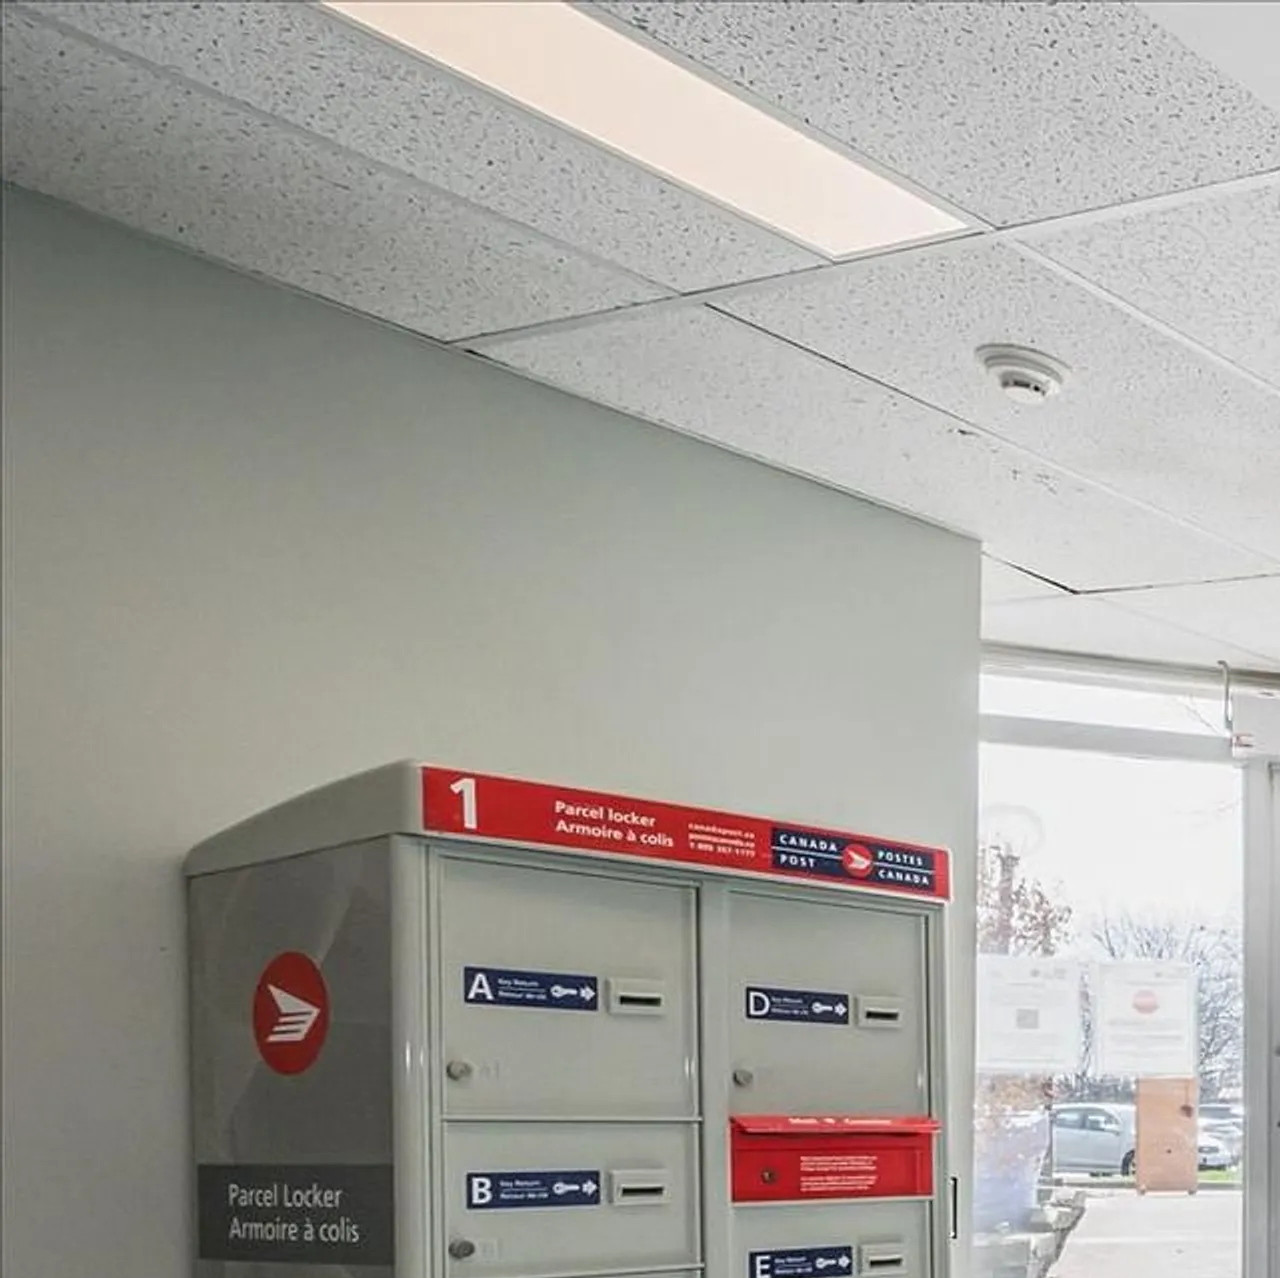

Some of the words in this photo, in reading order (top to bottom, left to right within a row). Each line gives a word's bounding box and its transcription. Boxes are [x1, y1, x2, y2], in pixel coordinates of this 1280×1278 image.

[450, 778, 477, 830] 1
[555, 800, 604, 820] Parcel
[608, 808, 656, 827] locker
[556, 819, 623, 840] Armoire
[640, 833, 674, 847] colis
[780, 834, 838, 852] CANADA
[780, 854, 815, 868] POST
[877, 851, 923, 867] POSTES
[877, 868, 930, 885] CANADA
[467, 973, 494, 1000] A
[749, 992, 770, 1015] D
[228, 1184, 278, 1207] Parcel
[284, 1183, 342, 1208] Locker
[471, 1177, 492, 1204] B
[229, 1216, 298, 1241] Armoire
[303, 1218, 314, 1241] à
[319, 1216, 360, 1243] colis
